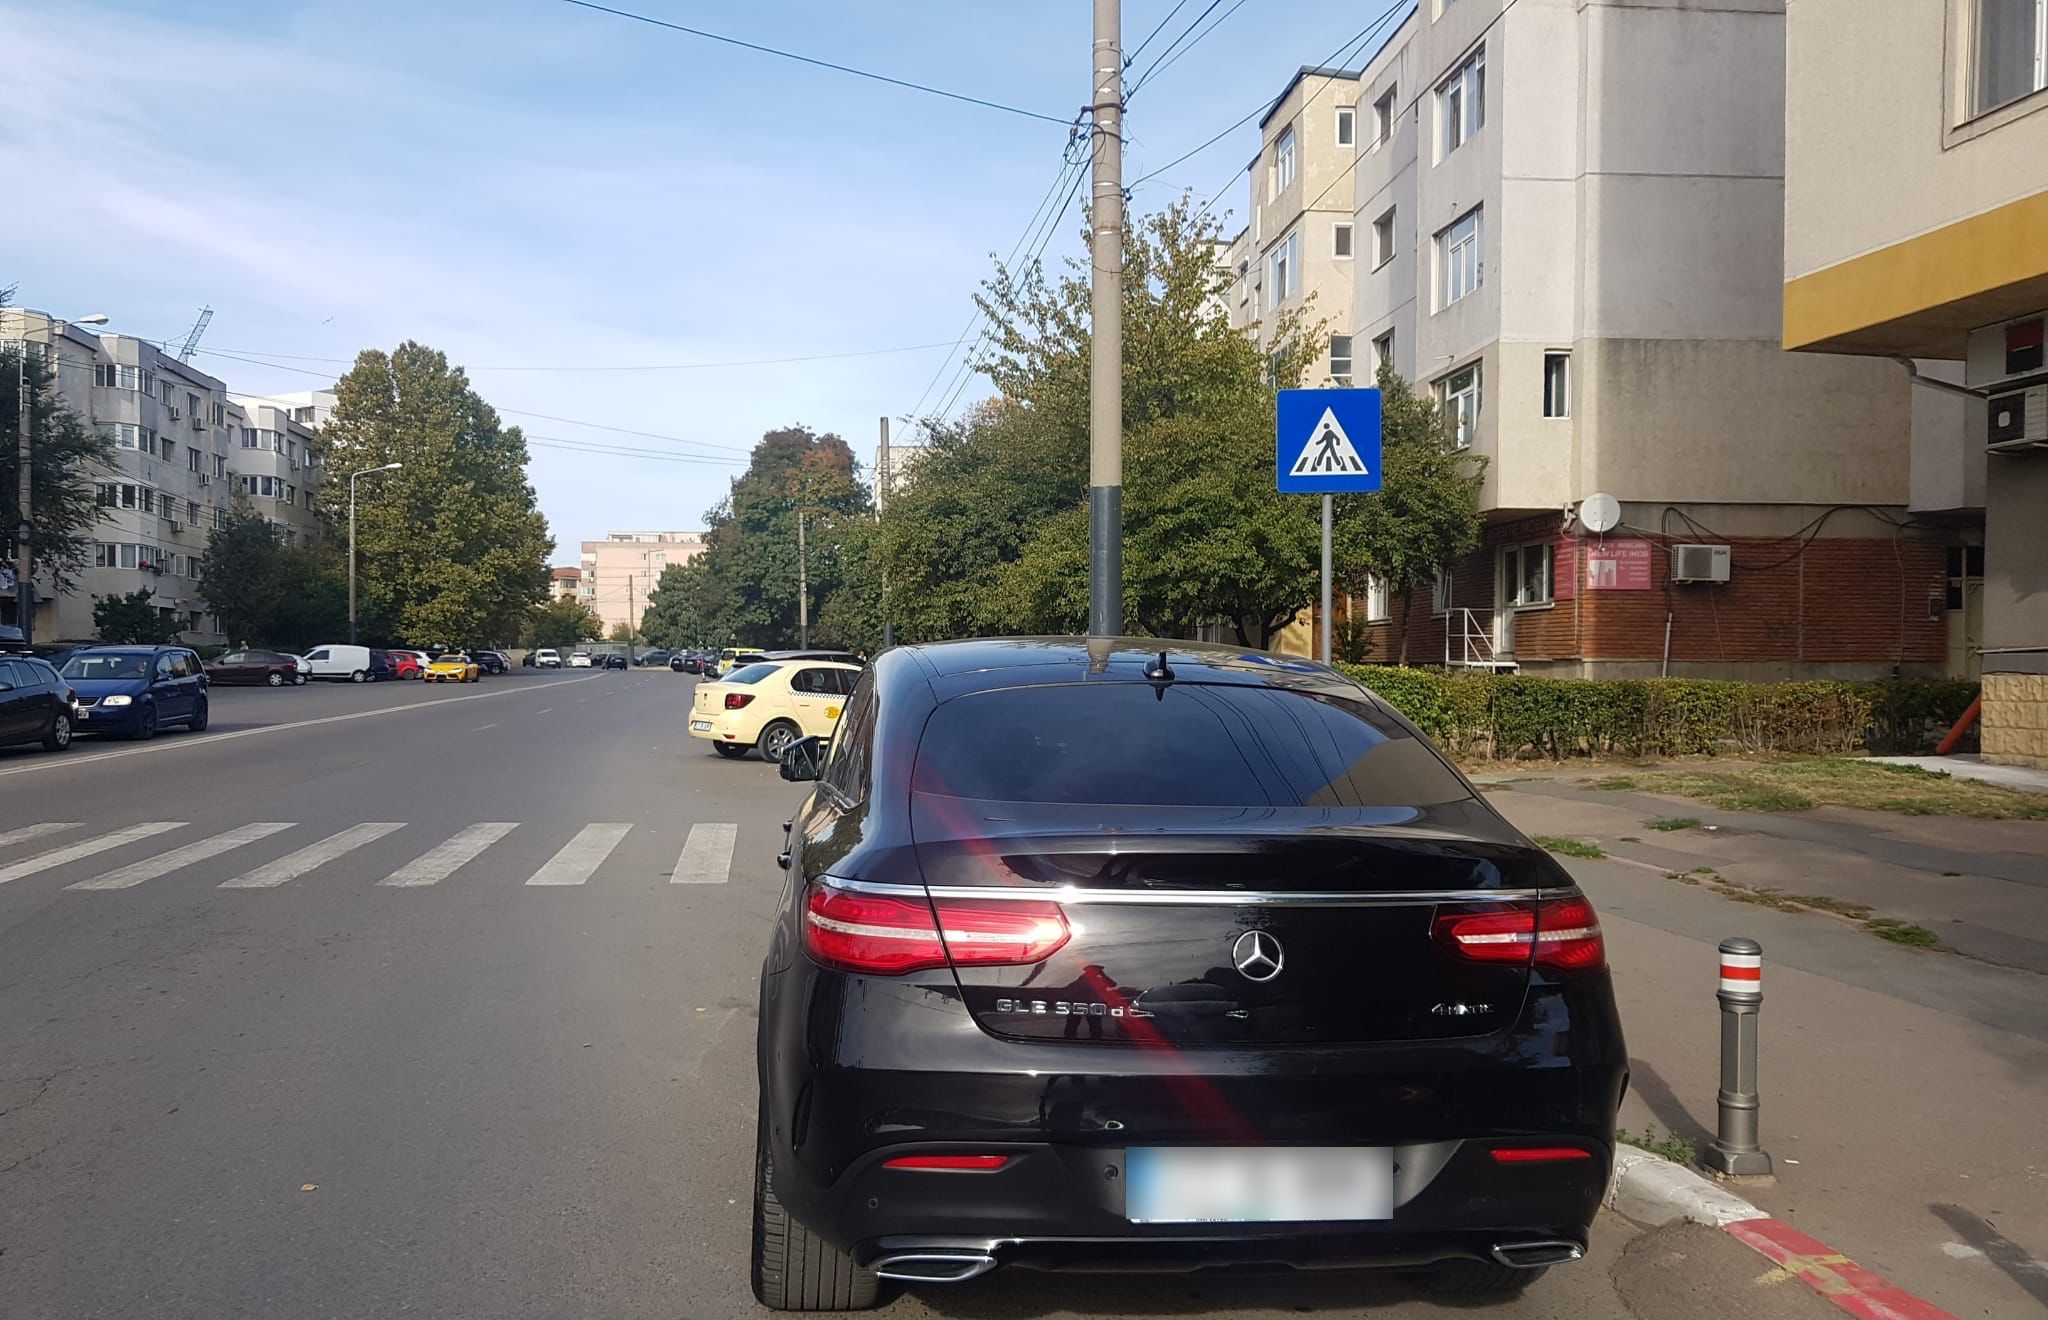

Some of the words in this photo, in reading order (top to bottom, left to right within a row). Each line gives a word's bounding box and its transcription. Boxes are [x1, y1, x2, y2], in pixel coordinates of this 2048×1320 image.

[1590, 550, 1610, 558] NEW
[1611, 550, 1628, 558] LIFE
[1629, 550, 1649, 558] IMOB
[996, 998, 1048, 1014] GLE
[1055, 1001, 1107, 1015] 350
[1111, 1006, 1124, 1017] d
